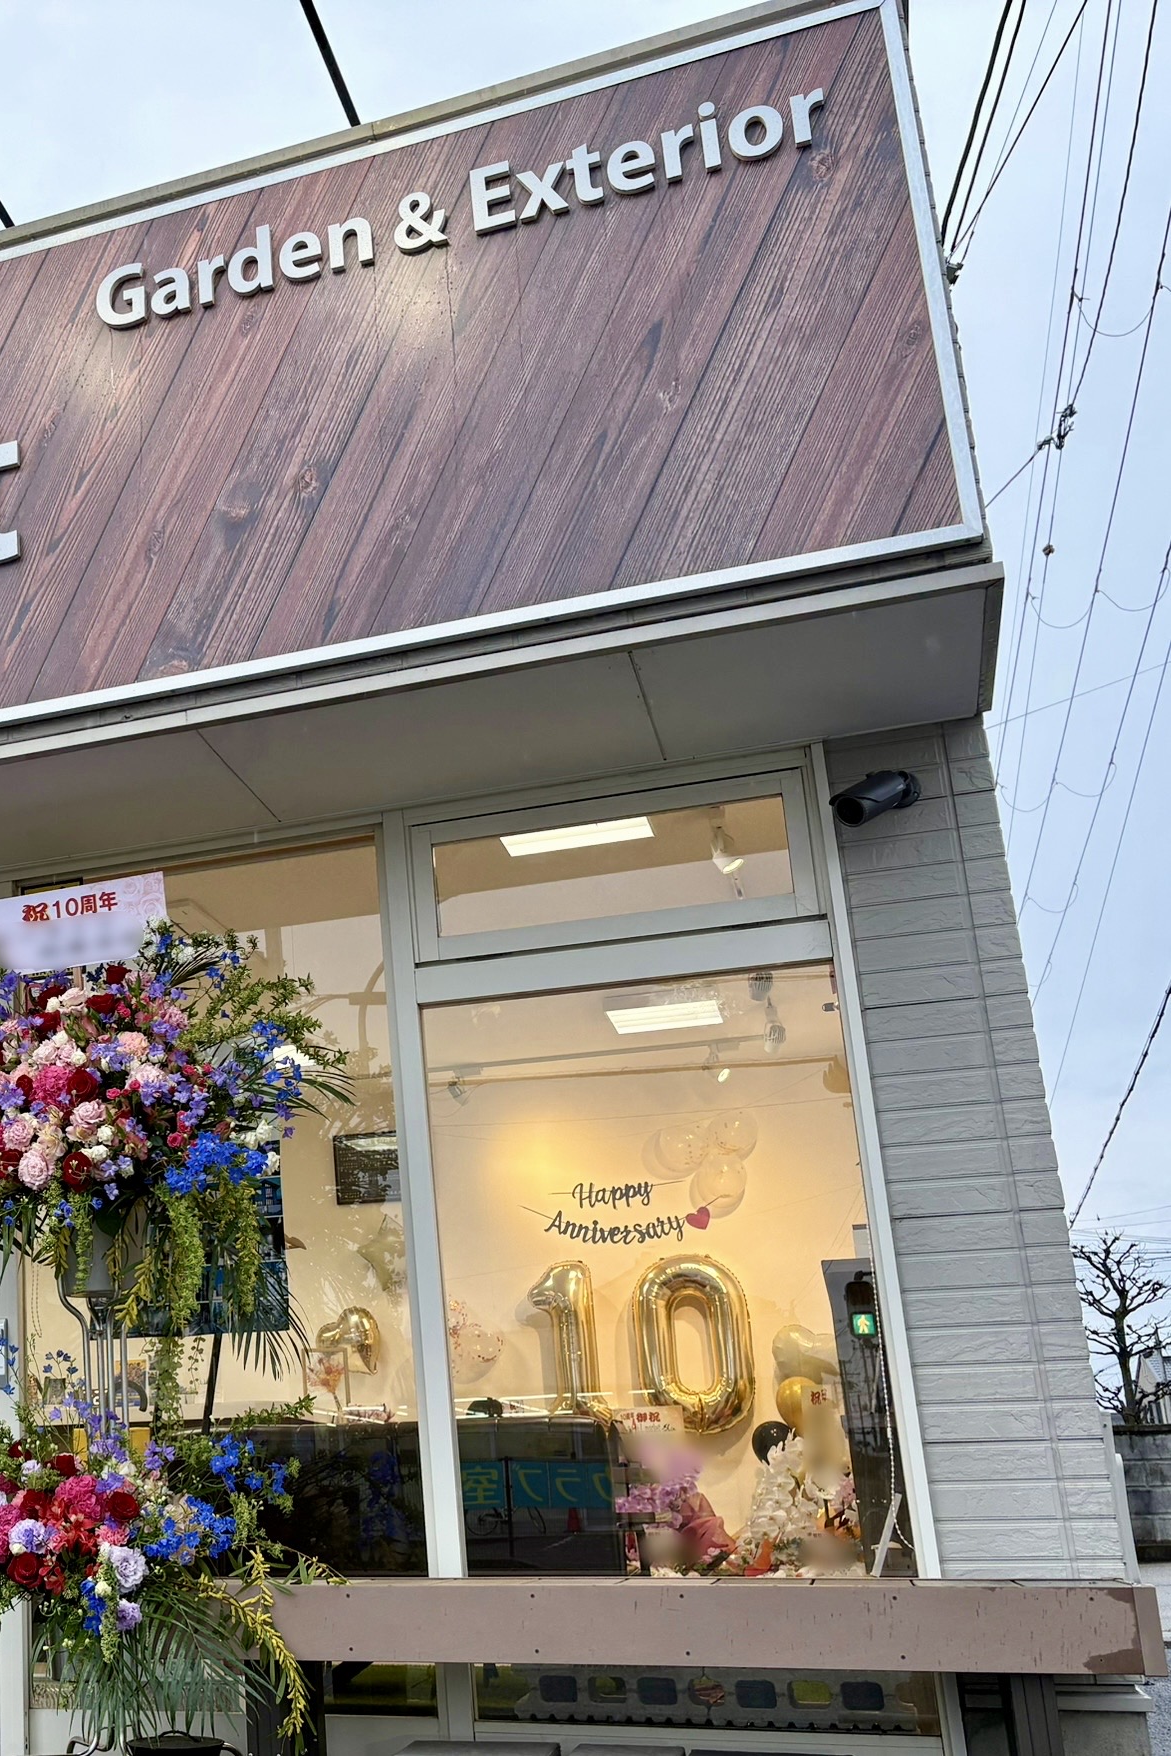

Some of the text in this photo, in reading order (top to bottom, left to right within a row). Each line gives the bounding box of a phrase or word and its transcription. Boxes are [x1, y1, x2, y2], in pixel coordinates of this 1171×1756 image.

[96, 87, 825, 329] Garden & Exterior
[571, 1181, 653, 1210] Happy
[544, 1210, 686, 1245] Anniversary
